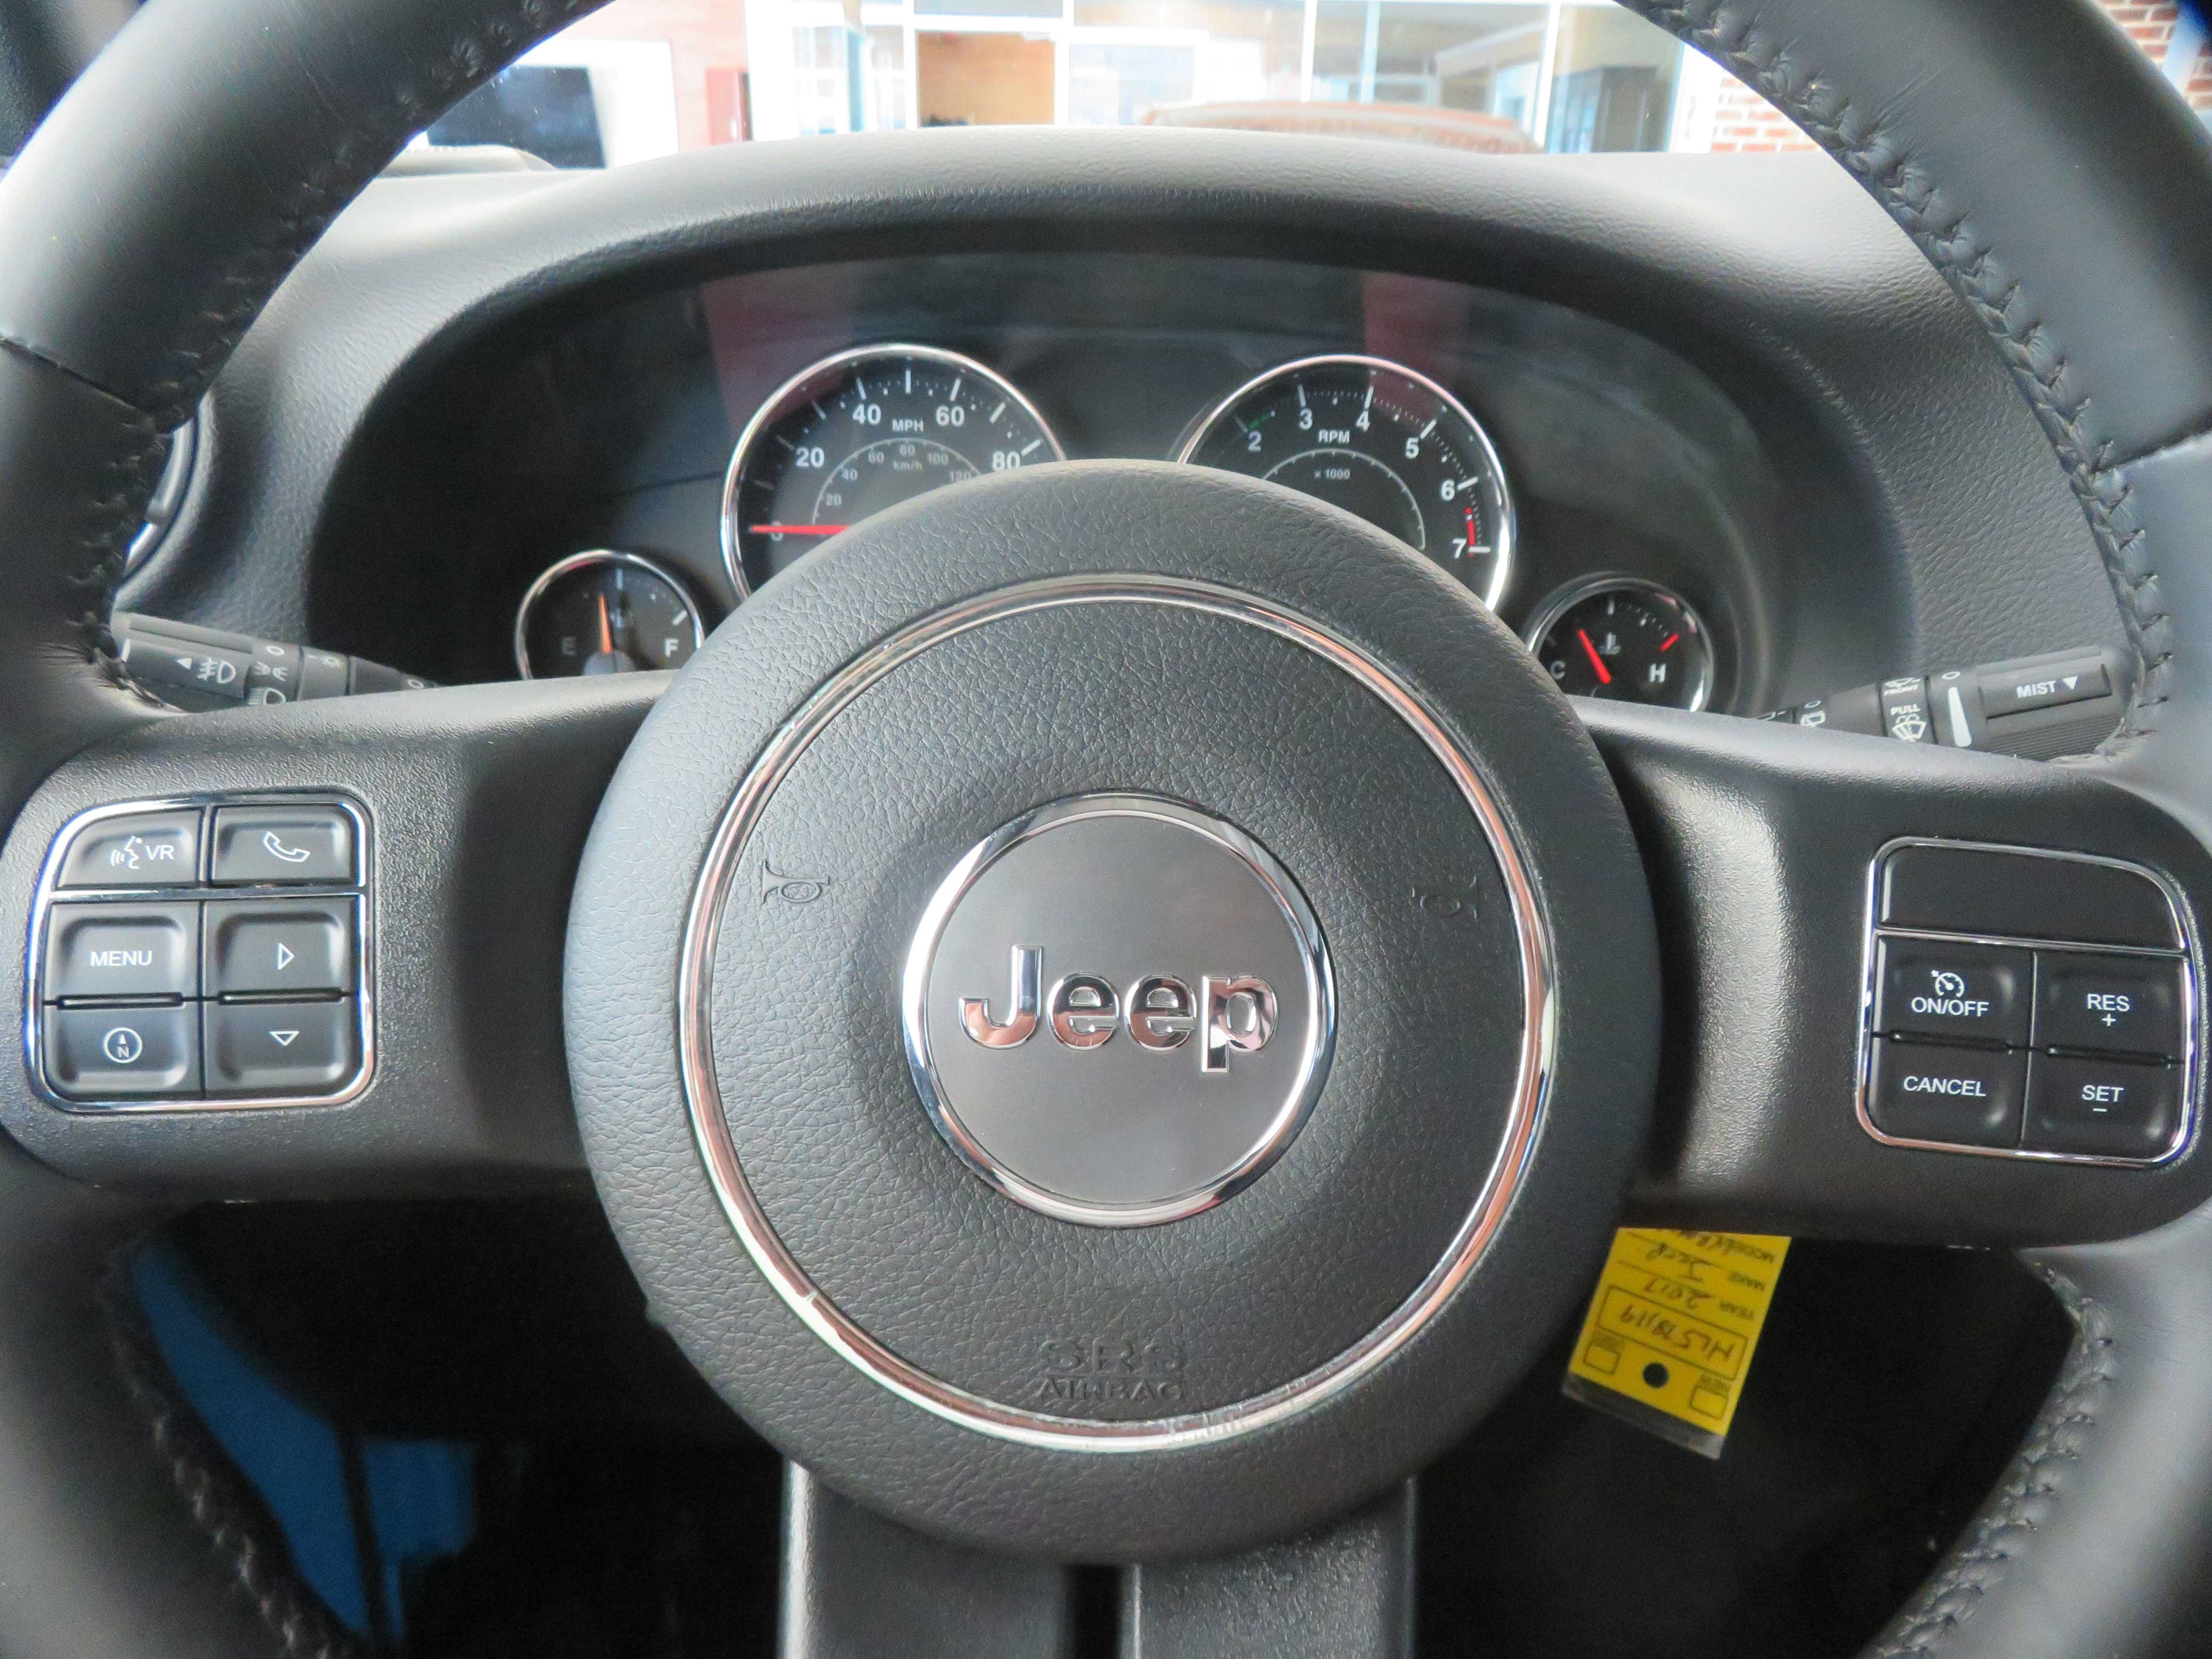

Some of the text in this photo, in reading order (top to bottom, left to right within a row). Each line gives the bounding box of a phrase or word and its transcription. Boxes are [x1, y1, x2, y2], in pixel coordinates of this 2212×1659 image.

[853, 404, 882, 425] 40
[936, 406, 965, 427] 60
[1299, 408, 1313, 430] 3
[1356, 410, 1370, 431] 4
[891, 419, 924, 432] MPH
[1248, 431, 1262, 452] 2
[1318, 429, 1350, 443] RPM
[795, 447, 825, 468] 20
[1405, 437, 1420, 459] 5
[893, 460, 923, 472] km/h
[927, 453, 949, 466] 100
[992, 451, 1021, 470] 80
[1325, 469, 1350, 480] 1000
[1441, 480, 1455, 501] 6
[1452, 538, 1467, 559] 7
[562, 637, 576, 655] E
[664, 638, 678, 658] F
[1550, 660, 1567, 680] C
[1648, 663, 1667, 683] H
[2017, 680, 2056, 698] MIST
[1891, 704, 1921, 716] PULL
[146, 844, 175, 860] VR
[90, 951, 153, 967] MENU
[959, 944, 1279, 1074] Jeep
[1911, 996, 1989, 1017] ON/OFF
[2087, 993, 2131, 1013] RES
[1903, 1076, 1987, 1097] CANCEL
[2081, 1085, 2124, 1103] SET
[1036, 1377, 1185, 1401] AIRBAG
